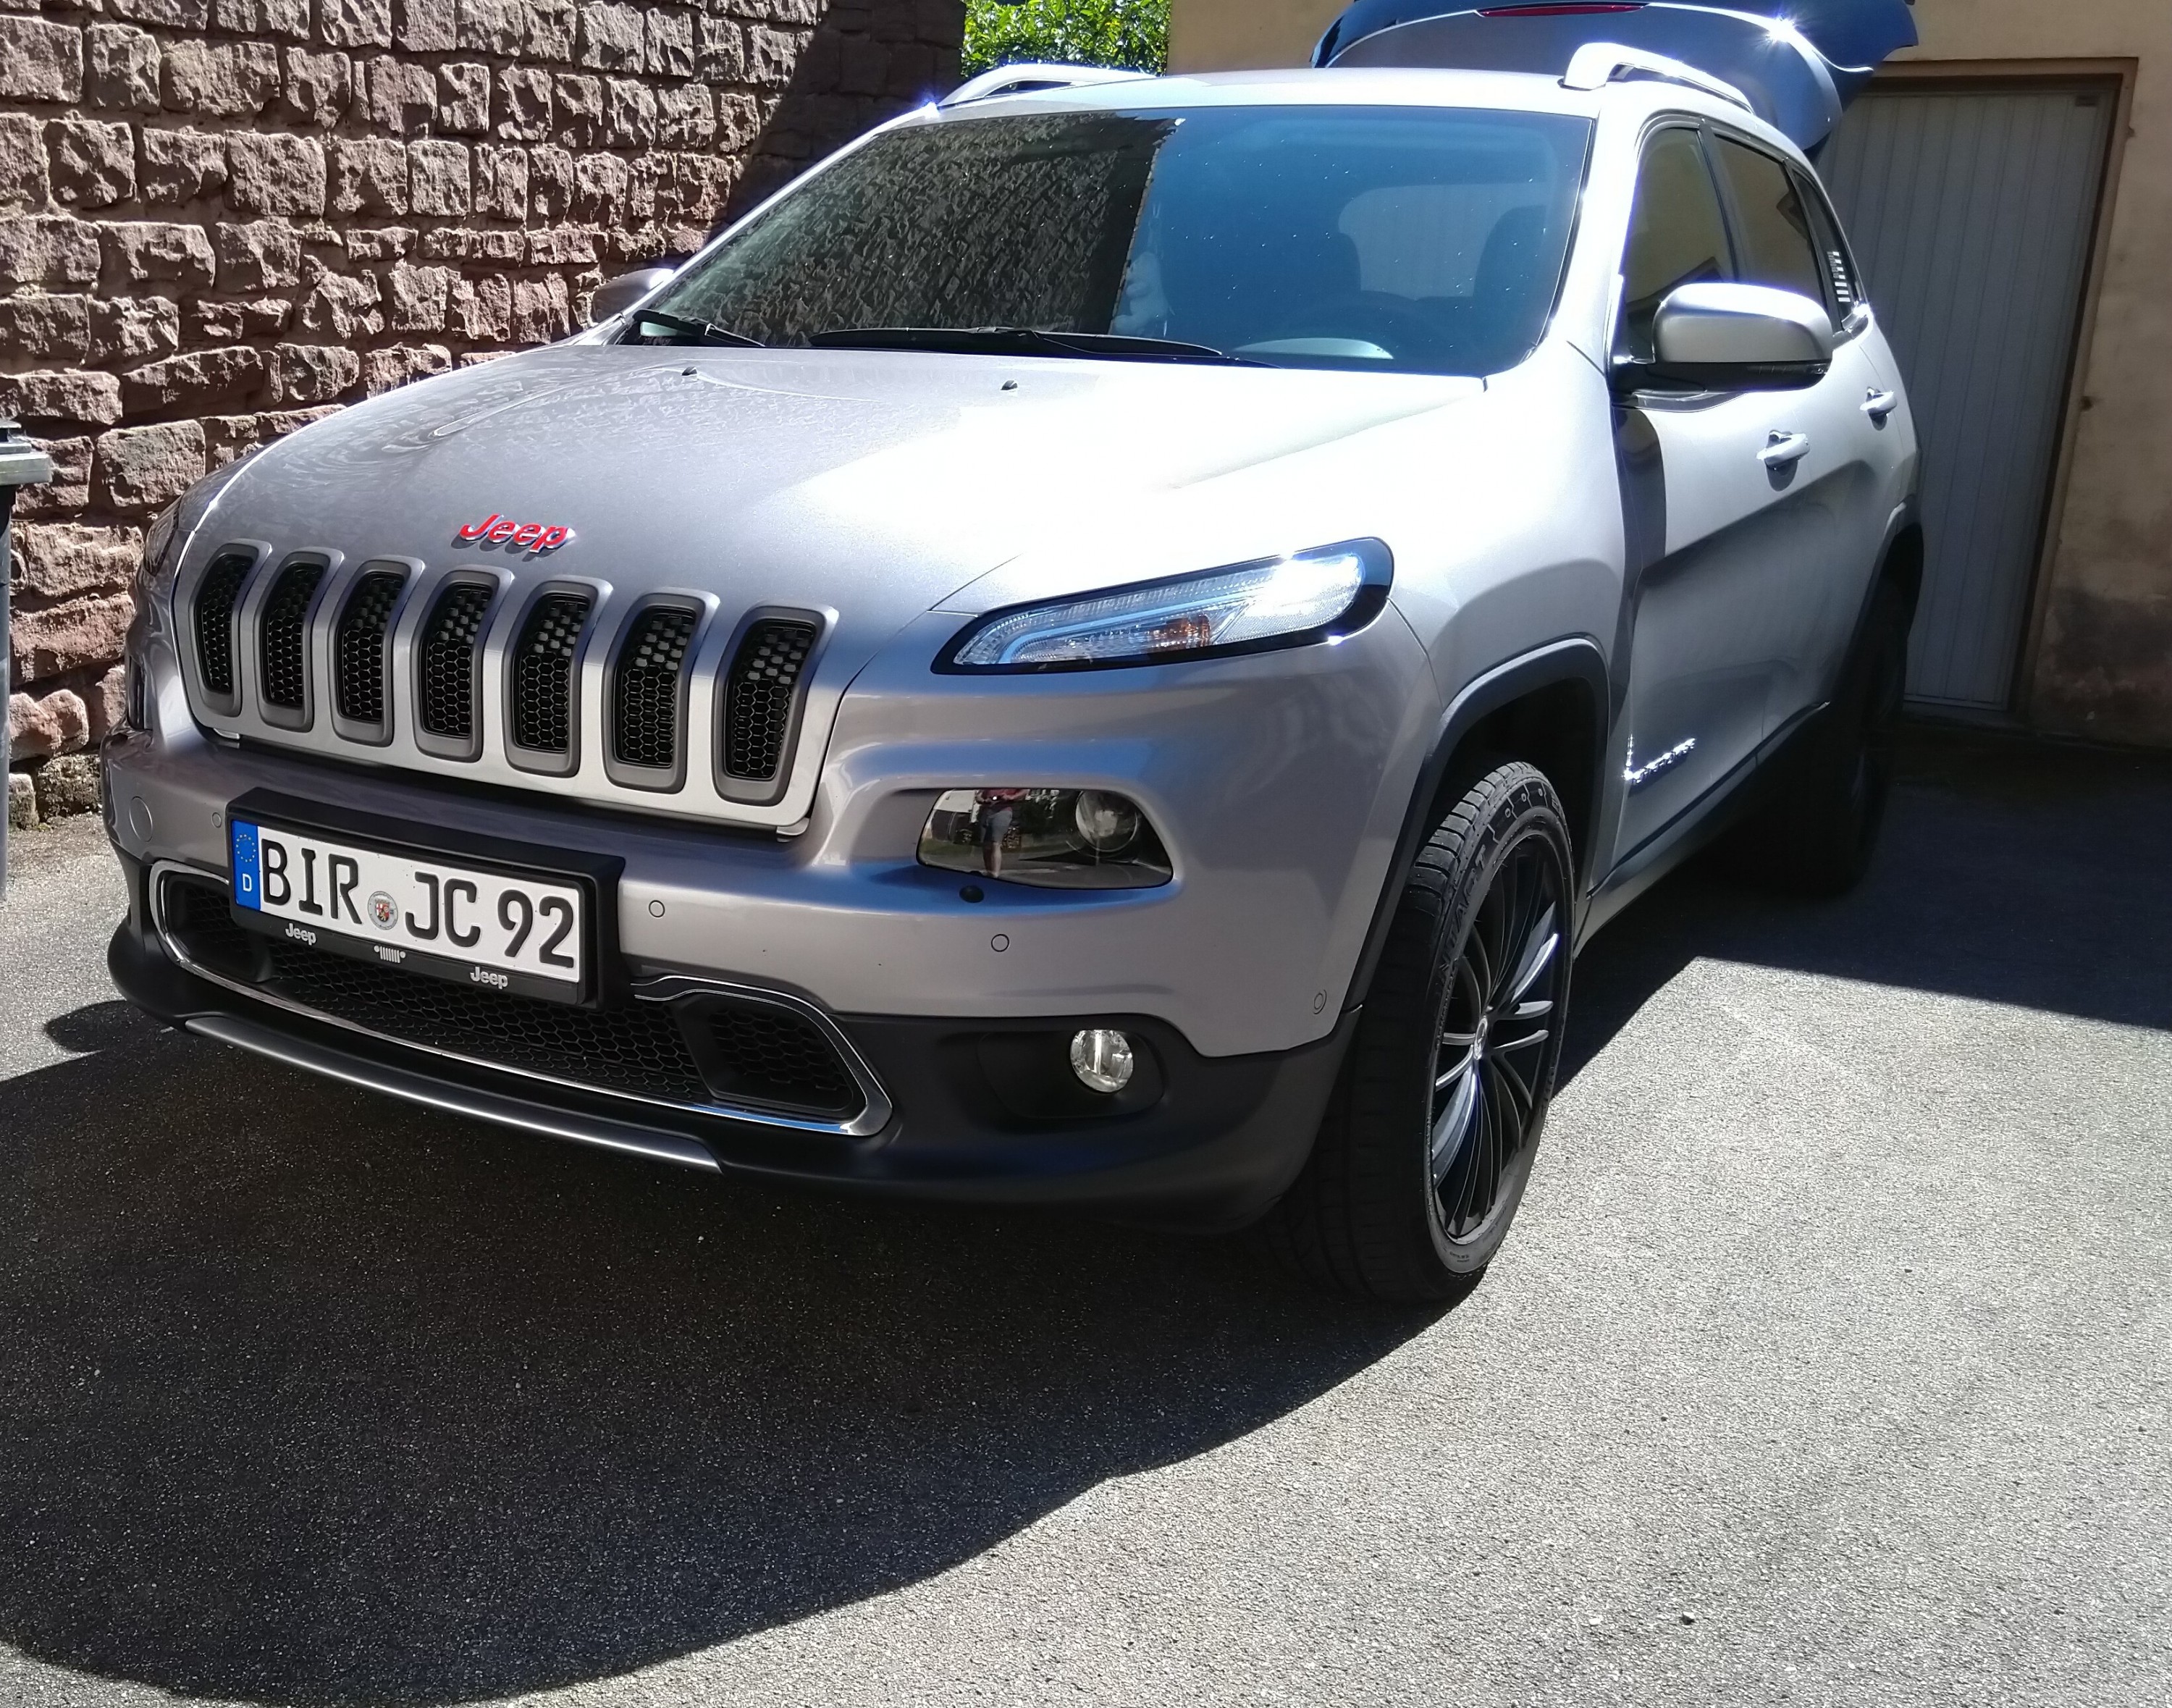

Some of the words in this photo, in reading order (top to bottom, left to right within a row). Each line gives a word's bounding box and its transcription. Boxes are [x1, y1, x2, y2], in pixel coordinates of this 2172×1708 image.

[460, 513, 573, 553] Jeep
[243, 872, 252, 892] D
[261, 838, 362, 925] BIR
[405, 871, 481, 948] JC
[497, 889, 574, 968] 92
[285, 922, 316, 946] Jeep
[470, 966, 508, 990] Jeep
